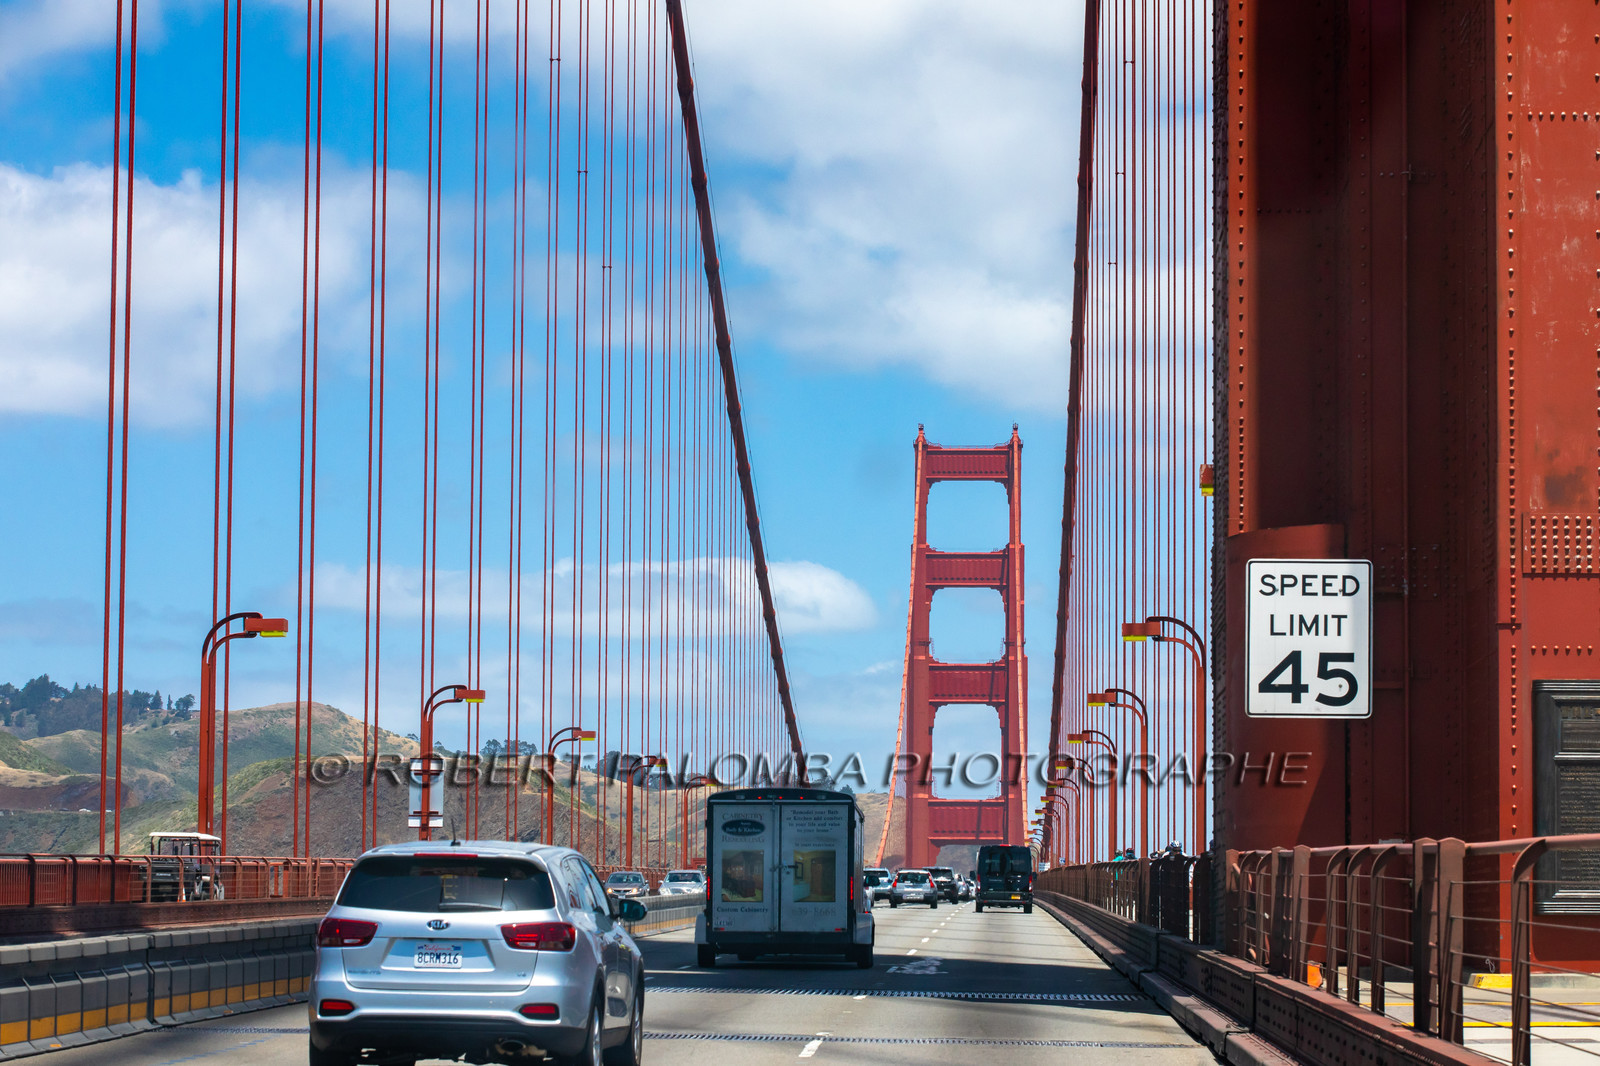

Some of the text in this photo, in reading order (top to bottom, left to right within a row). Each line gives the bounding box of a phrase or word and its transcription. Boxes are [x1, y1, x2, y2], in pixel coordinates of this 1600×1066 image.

[1259, 574, 1360, 597] SPEED
[1270, 614, 1348, 637] LIMIT
[1258, 650, 1359, 707] 45
[740, 906, 769, 914] Cabinetry
[430, 920, 447, 928] KIA
[417, 952, 460, 964] 8CRM316
